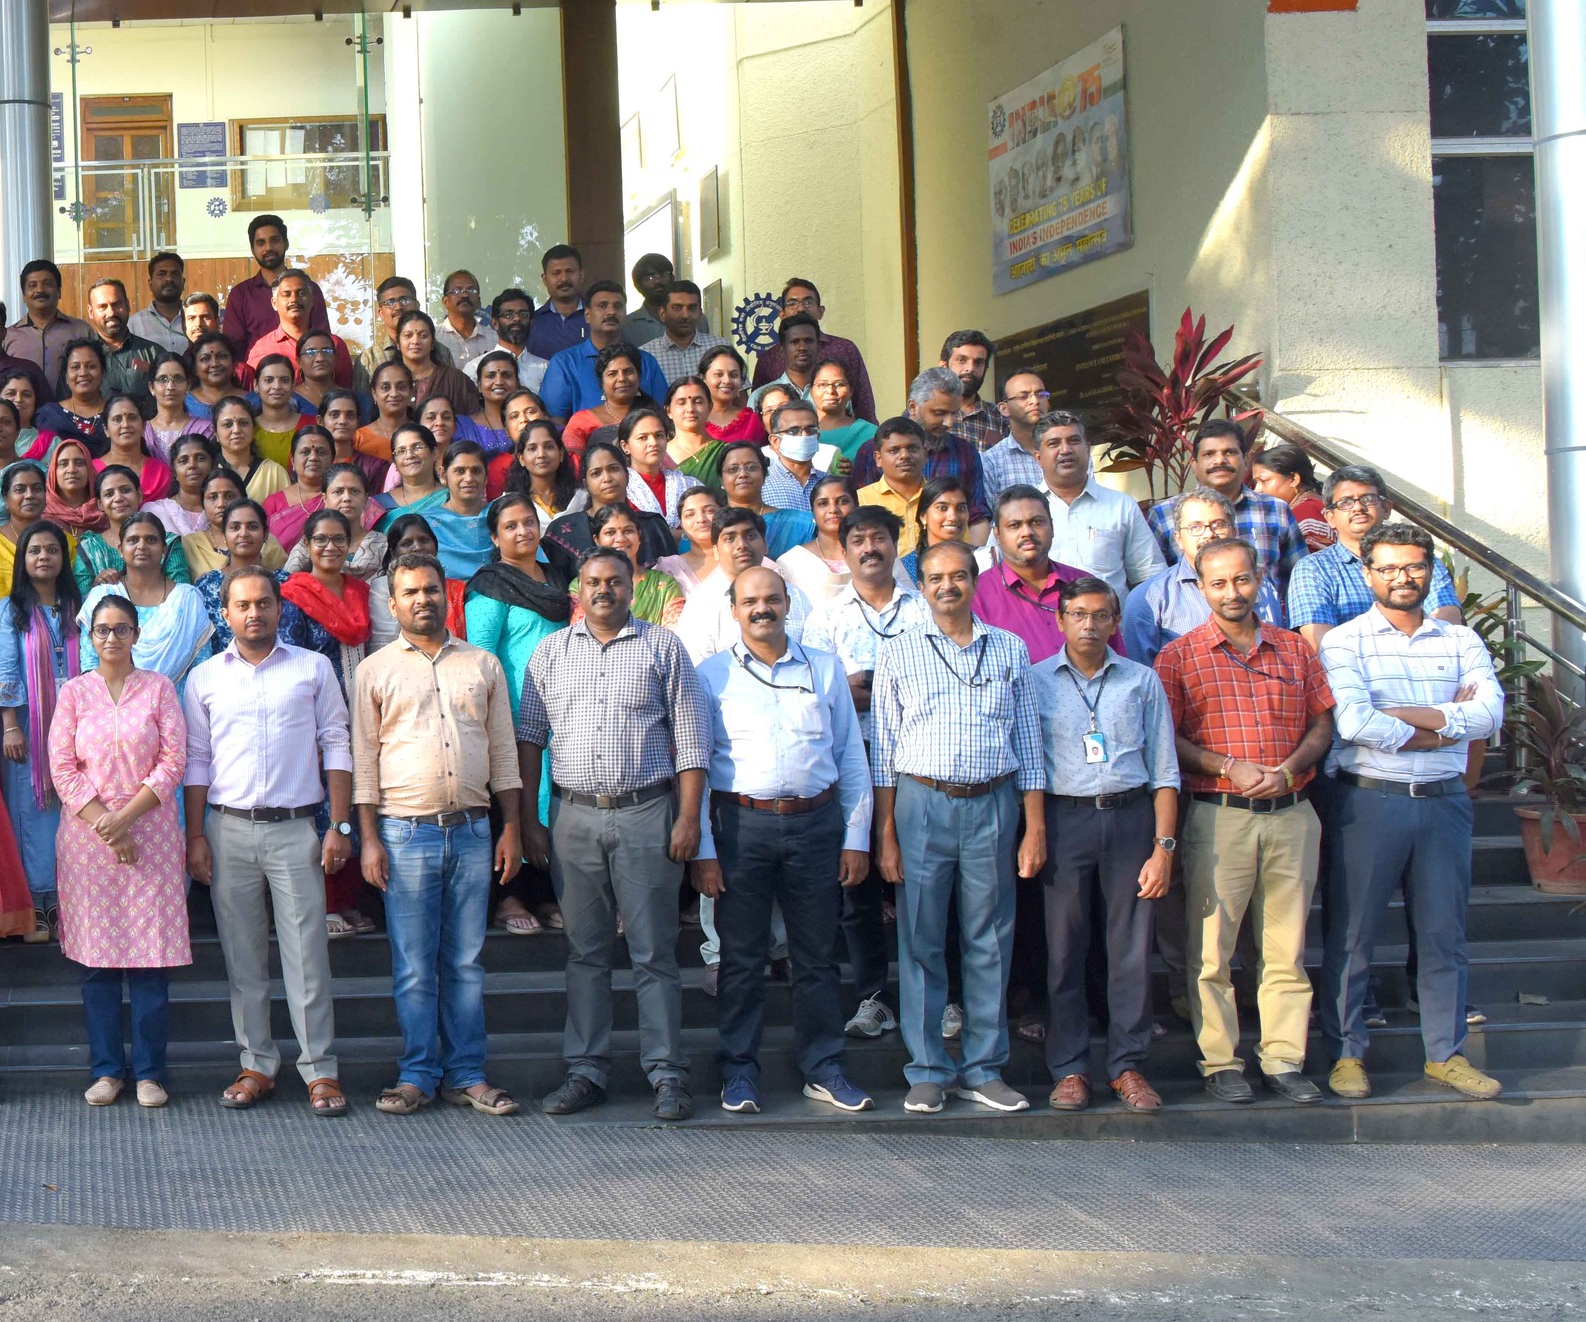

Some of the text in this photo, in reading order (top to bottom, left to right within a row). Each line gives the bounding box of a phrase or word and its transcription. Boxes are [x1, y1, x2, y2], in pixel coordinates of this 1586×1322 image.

[1008, 177, 1107, 235] CELEBRATING 75 YEARS OF
[1009, 200, 1108, 256] INDIA'S INDEPENDENCE
